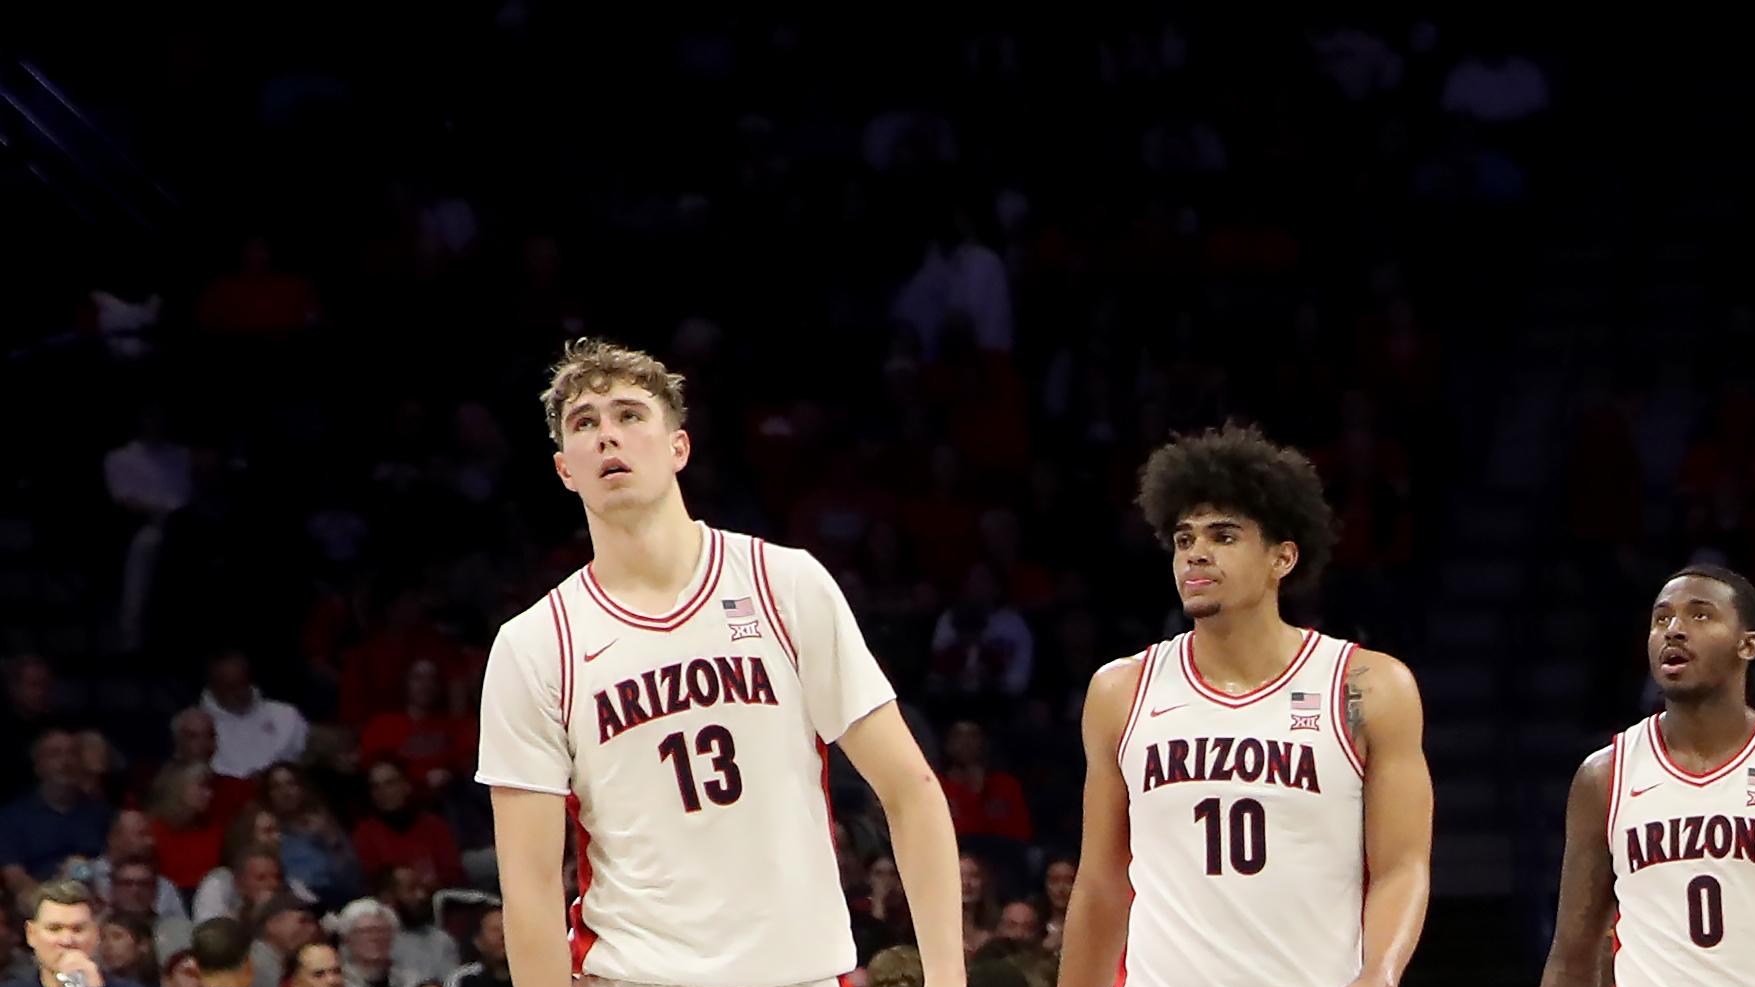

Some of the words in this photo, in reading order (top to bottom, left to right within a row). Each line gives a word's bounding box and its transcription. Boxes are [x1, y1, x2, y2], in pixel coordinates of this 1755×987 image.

[593, 656, 779, 745] ARIZONA
[657, 724, 743, 813] 13
[1143, 737, 1321, 794] ARIZONA
[1193, 797, 1267, 876] 10
[1687, 874, 1724, 949] 0
